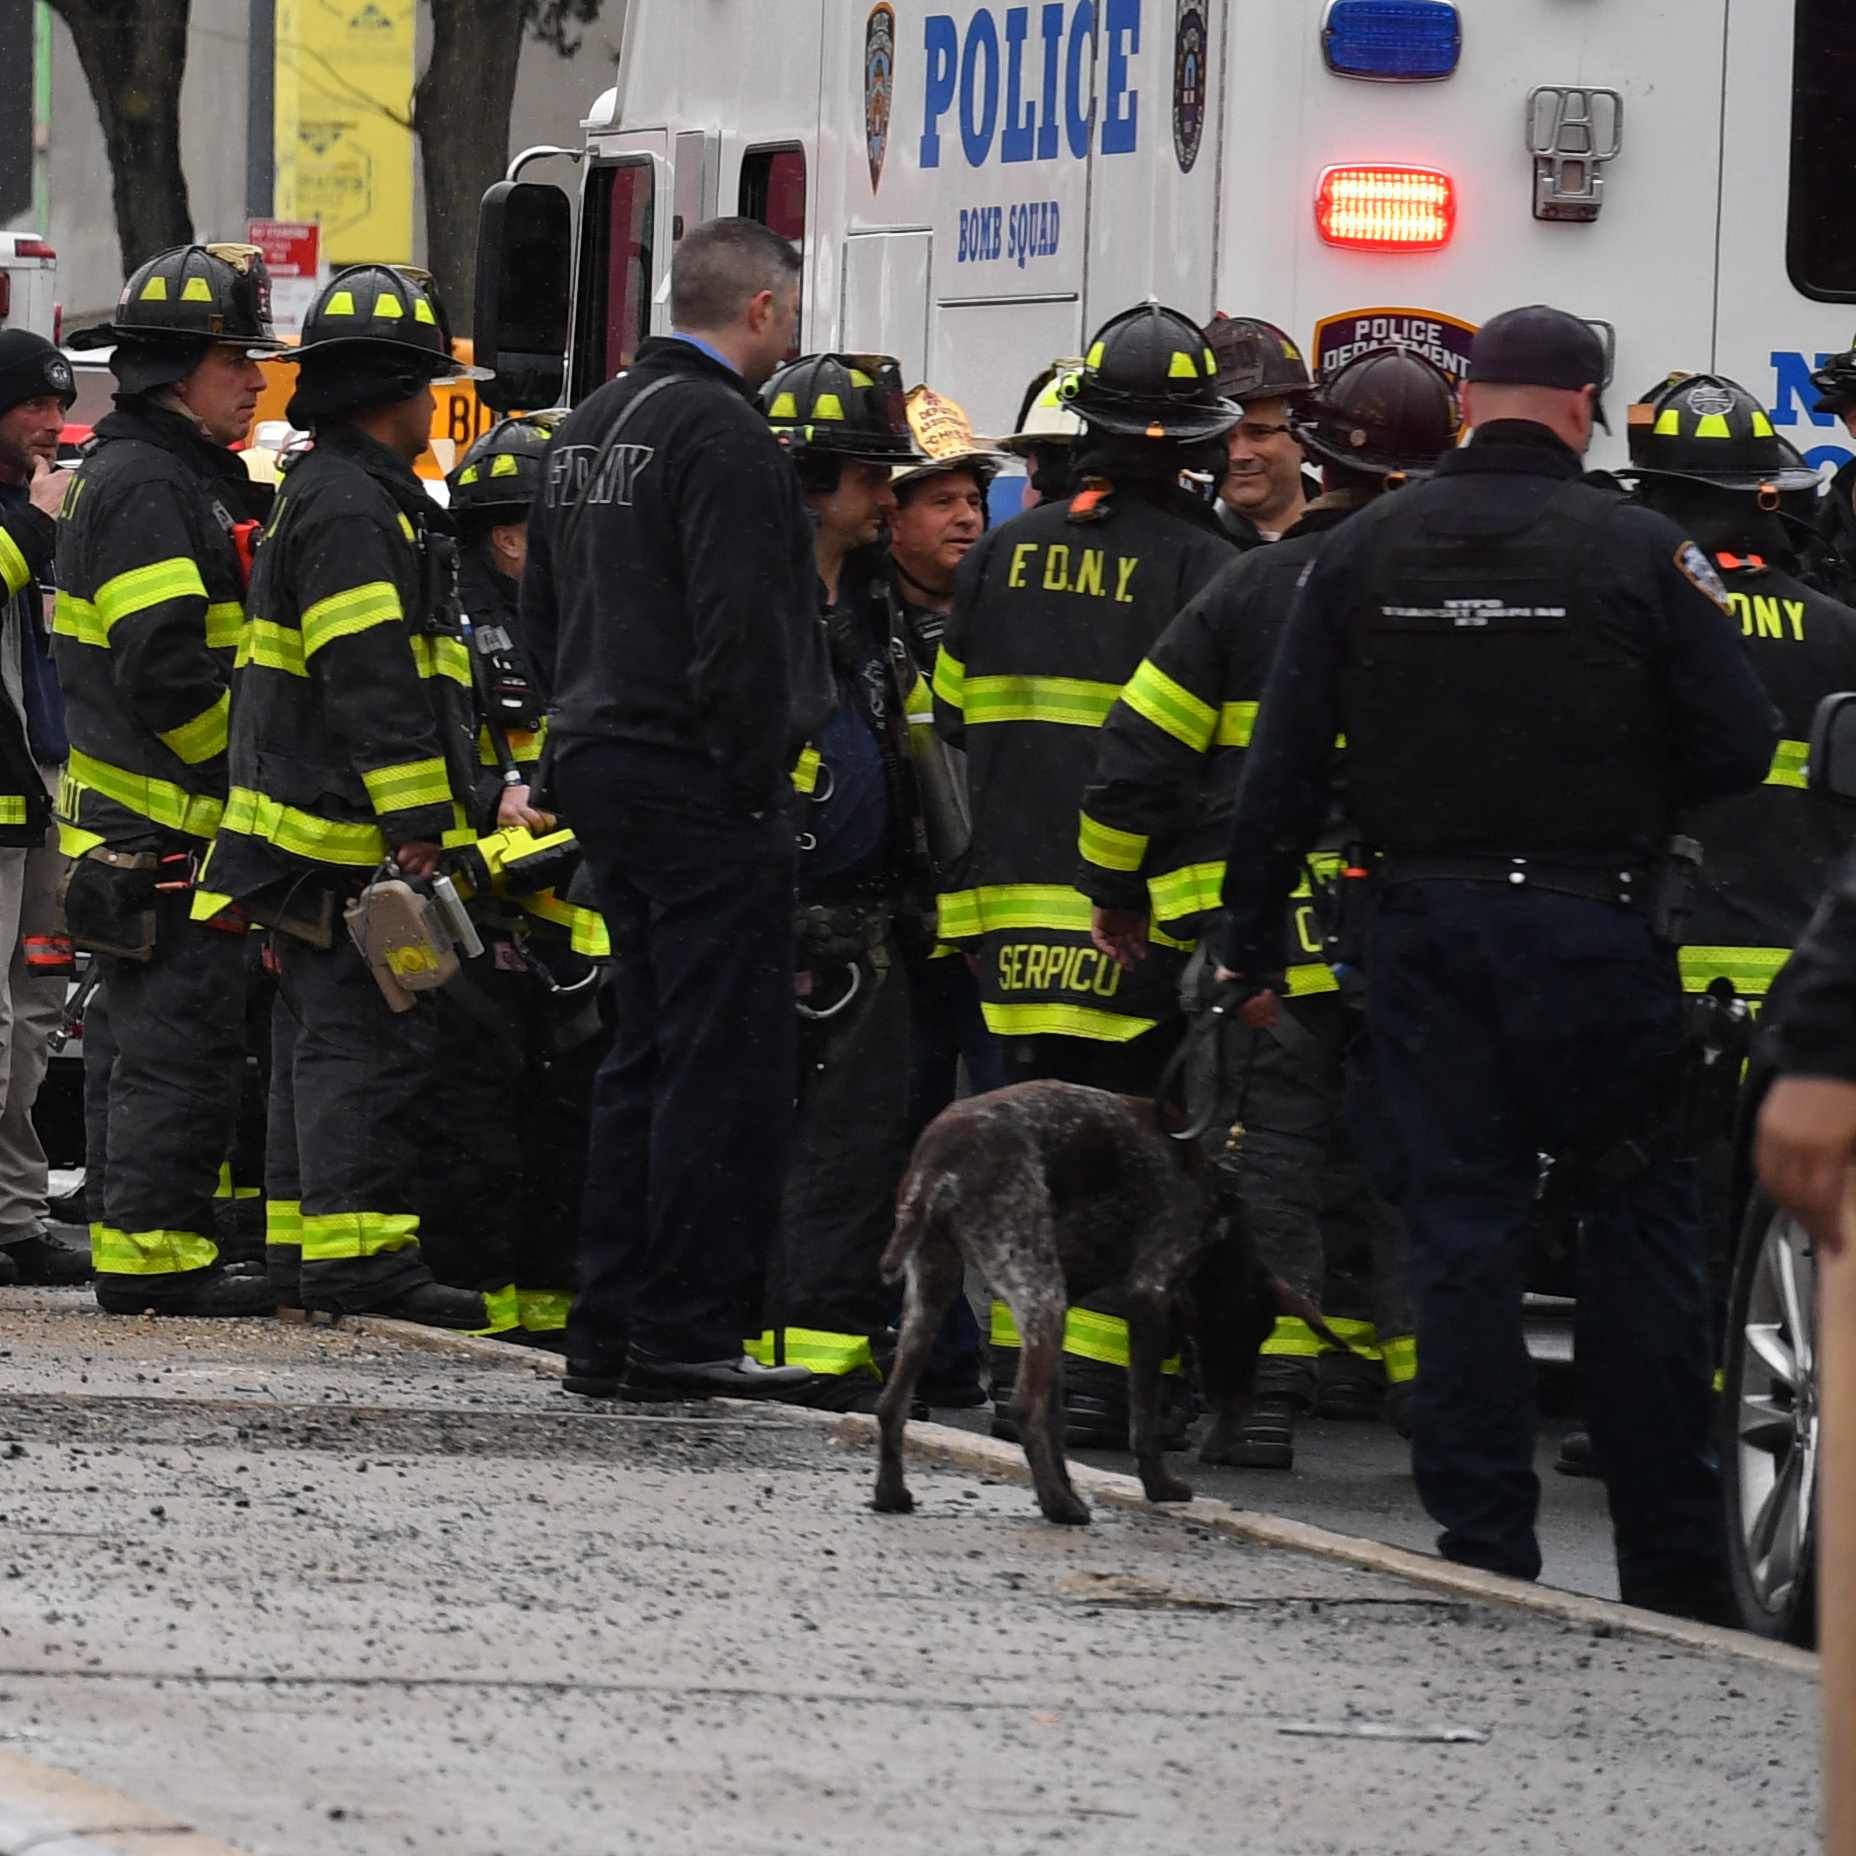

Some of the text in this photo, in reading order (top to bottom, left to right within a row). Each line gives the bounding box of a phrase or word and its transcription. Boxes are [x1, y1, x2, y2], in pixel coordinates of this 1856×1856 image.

[957, 200, 1060, 270] BOMB SQUAD
[1355, 317, 1443, 345] POLICE
[548, 443, 656, 509] FDNY
[998, 943, 1121, 997] SERPICO
